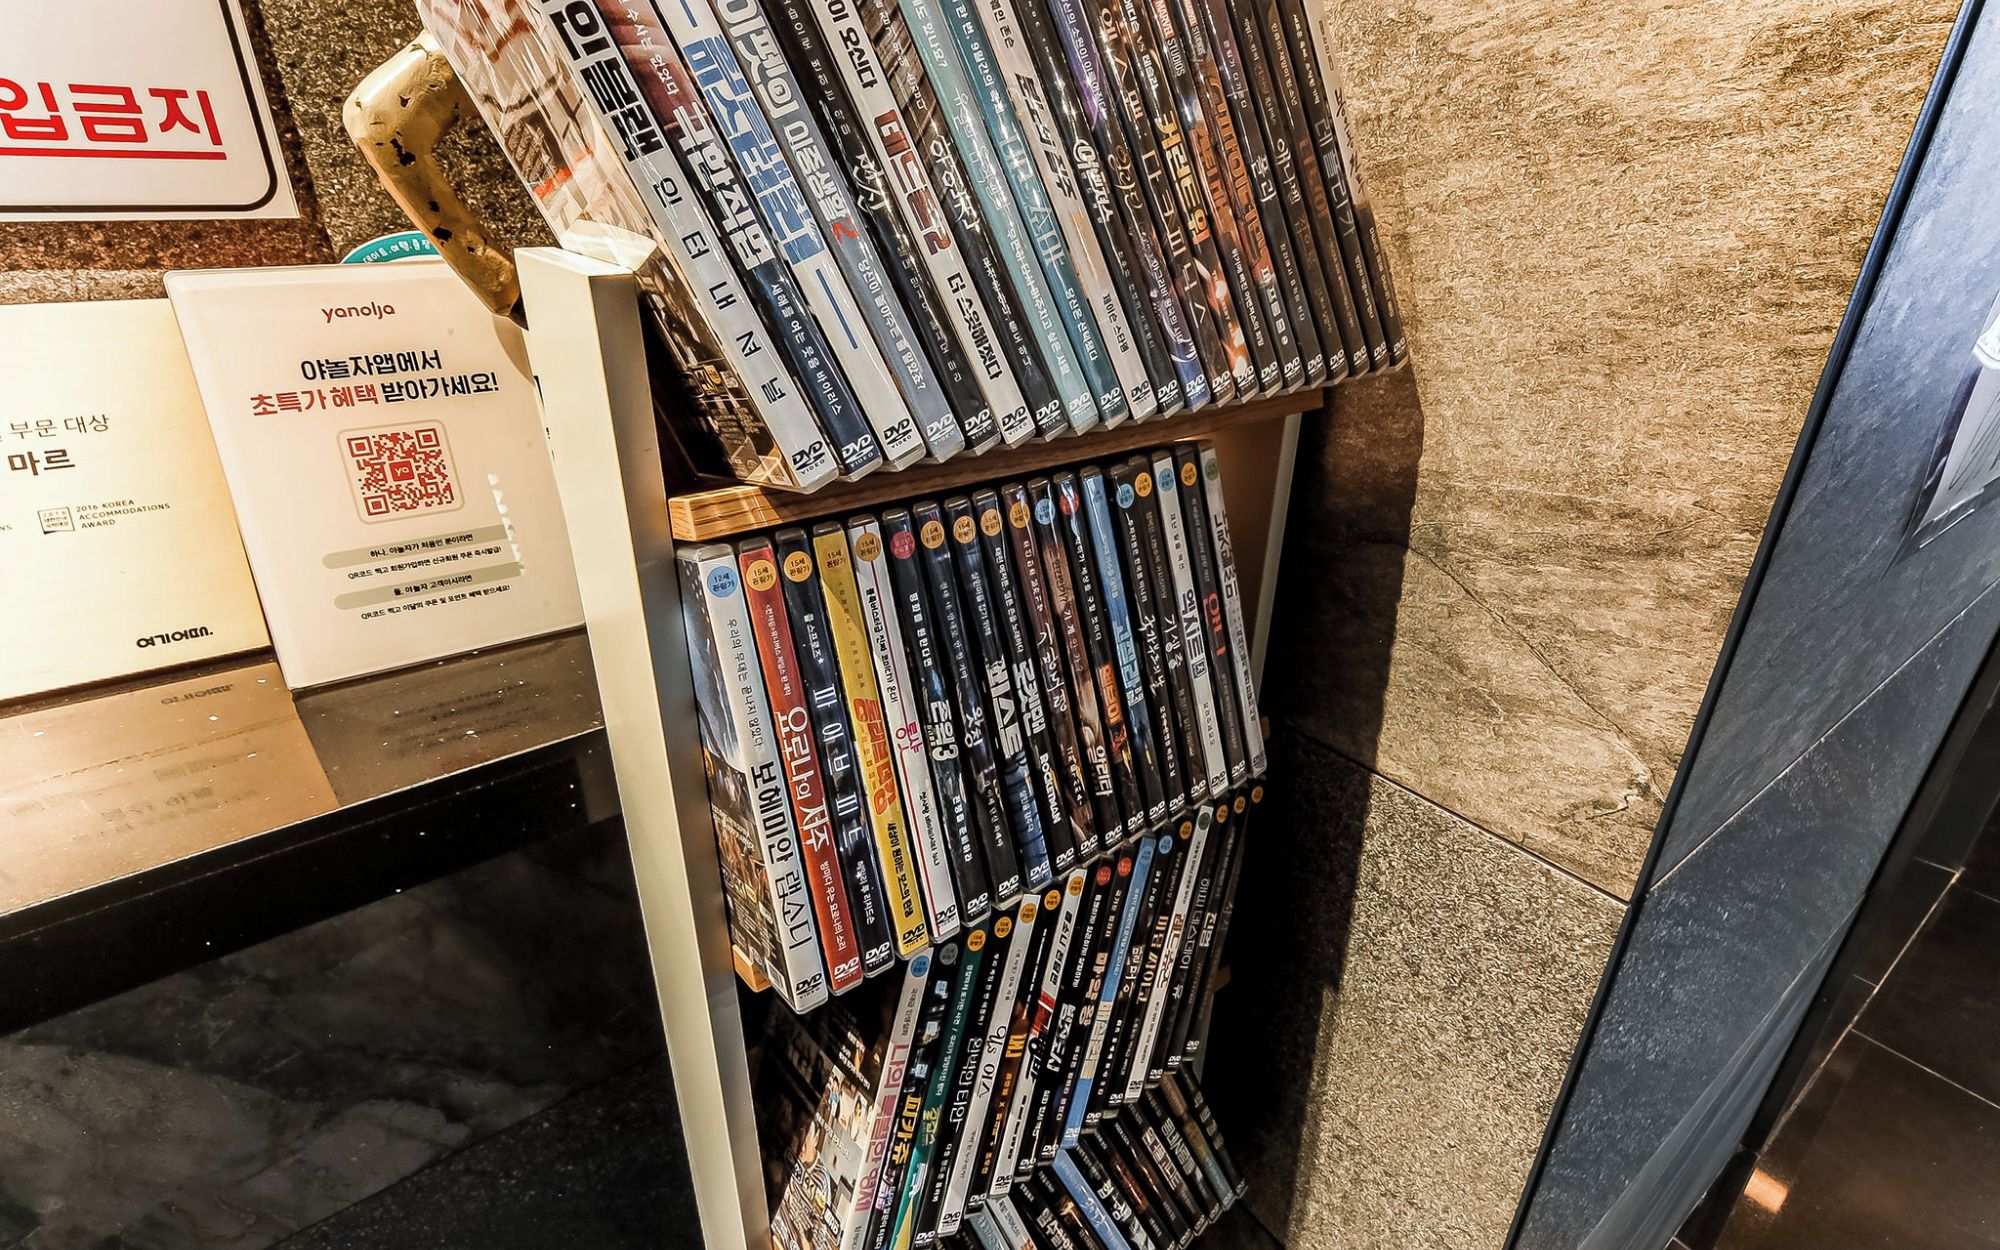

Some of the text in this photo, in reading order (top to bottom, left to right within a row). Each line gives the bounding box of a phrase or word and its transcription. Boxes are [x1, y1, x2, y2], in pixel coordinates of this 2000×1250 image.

[838, 25, 878, 91] 오신다
[921, 22, 948, 69] 있나요?
[955, 4, 994, 87] 한 9일간의
[1165, 37, 1185, 76] STUDIOS
[648, 53, 679, 96] 없었다
[0, 77, 223, 146] 입금지
[667, 98, 775, 271] 극한직업
[321, 301, 395, 323] yanolja
[856, 258, 881, 293] 당신이
[873, 294, 902, 339] 놀아주는
[900, 351, 927, 391] 알았죠?
[946, 272, 1003, 381] 더 스윗해졌다
[1100, 294, 1118, 323] 제이슨
[301, 350, 442, 381] 야놀자앱에서
[769, 281, 843, 416] 새해를 여는 웃음 바이러스
[250, 372, 499, 416] 초특가 혜택 받아가세요!
[9, 414, 110, 439] 부문 대상
[883, 418, 910, 440] DVD
[1000, 406, 1027, 428] DVD
[8, 449, 75, 476] 마르
[792, 440, 825, 465] DVD
[76, 499, 134, 512] 2016 KOREA
[79, 503, 170, 520] ACCOMMODATIONS
[81, 519, 116, 529] AWARD
[389, 543, 419, 555] 야놀자가
[421, 538, 443, 549] 처음인
[445, 533, 473, 545] 분이라면
[348, 569, 373, 580] QR코드
[390, 558, 431, 572] 회원가입하면
[432, 553, 459, 565] 신규회원
[405, 583, 428, 593] 야놀자
[430, 574, 473, 588] 고객이시라면
[361, 609, 386, 620] QR코드
[402, 601, 424, 612] 이달의
[908, 592, 933, 667] 평화를 원한다면
[1177, 589, 1204, 659] 엑시트
[875, 635, 887, 652] 진짜
[1160, 615, 1183, 669] 기생충
[725, 618, 764, 747] 우리의 무대는 끝나지 않았다
[963, 707, 985, 746] 왓칭
[1011, 658, 1061, 823] 로켓맨 ROCKETMAN
[775, 706, 834, 852] 요로나의 저주
[1087, 745, 1113, 799] 알리타
[751, 761, 794, 864] 보헤미안
[773, 870, 812, 948] 랩소디
[886, 822, 899, 846] 세상이
[819, 860, 847, 951] 밤마다 우는 요로나의 소리
[865, 942, 890, 960] DVD
[1178, 909, 1202, 969] 데스데이
[795, 973, 822, 991] DVD
[882, 1040, 909, 1095] 나의
[889, 1093, 922, 1166] 피카츄
